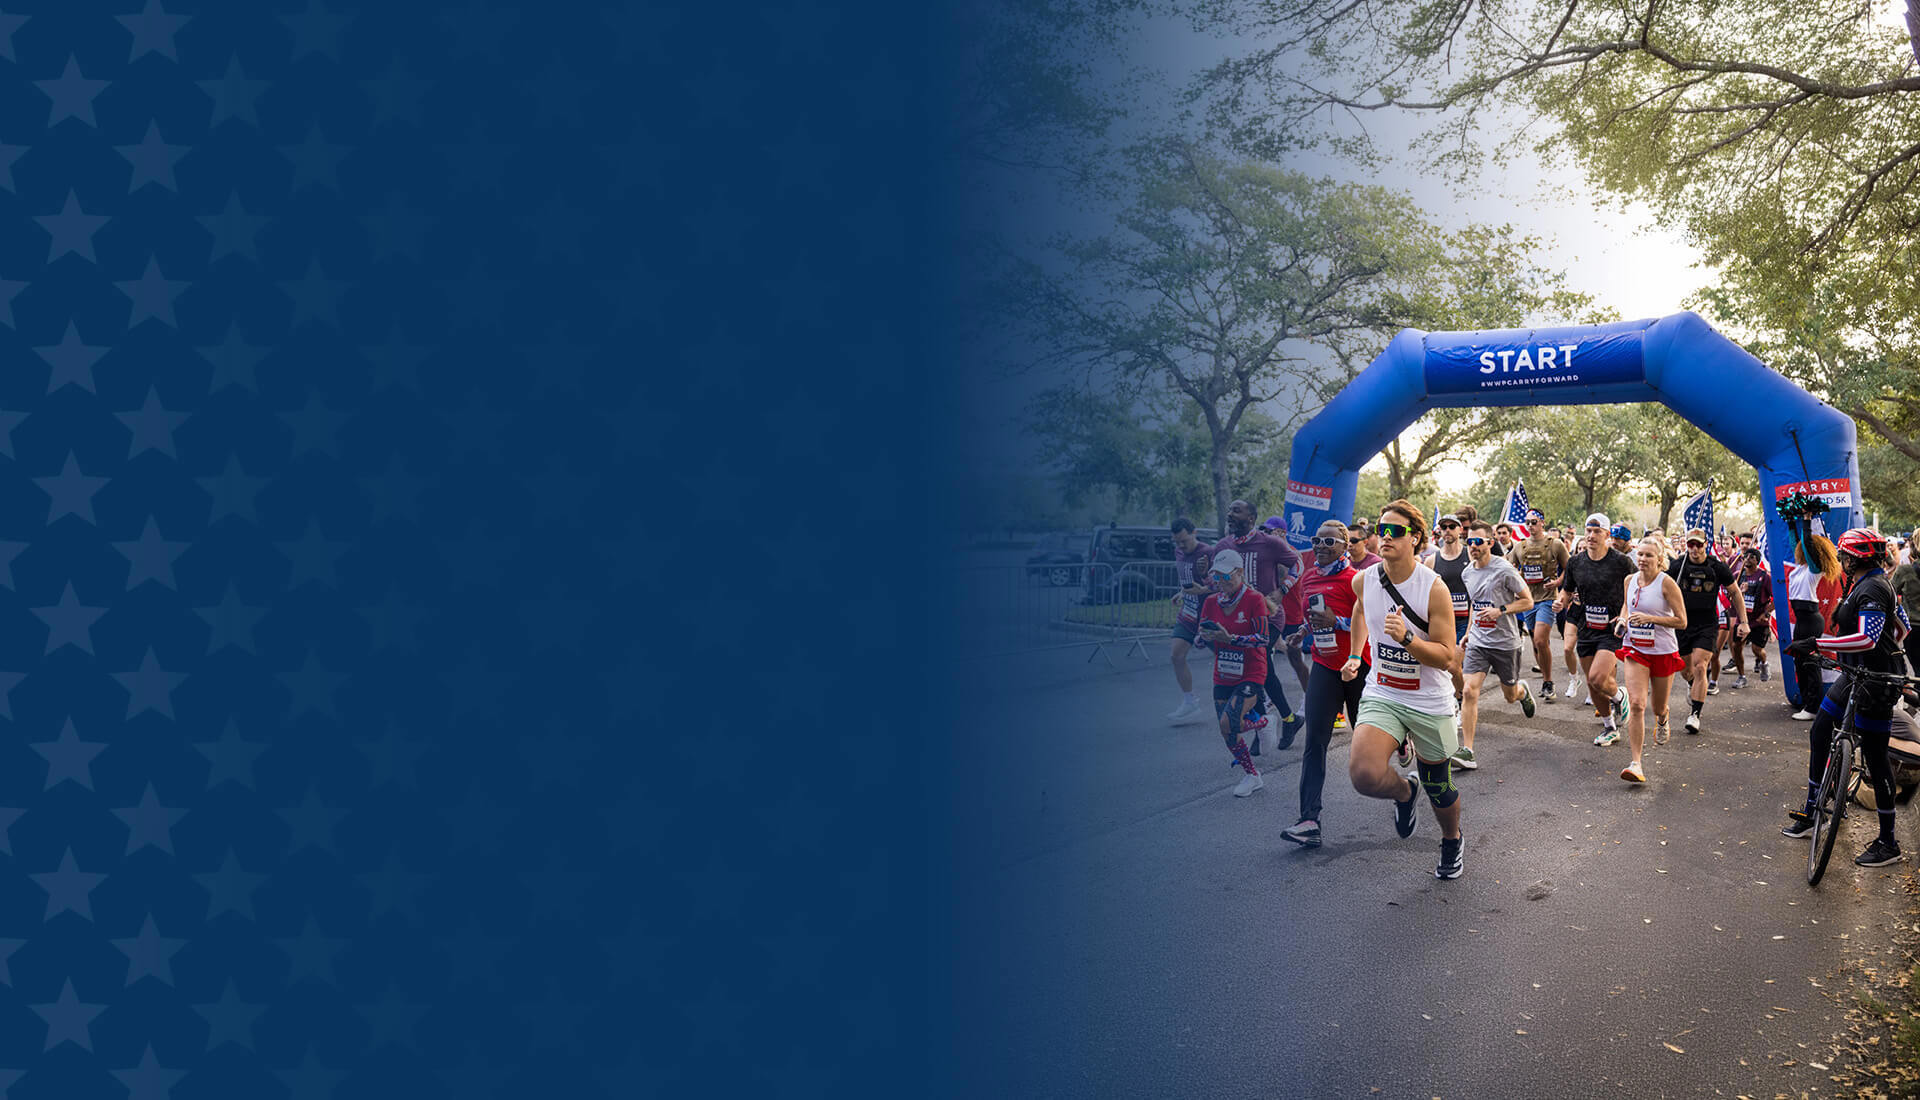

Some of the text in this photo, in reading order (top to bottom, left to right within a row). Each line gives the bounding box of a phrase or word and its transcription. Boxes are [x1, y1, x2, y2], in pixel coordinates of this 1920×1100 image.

[1479, 345, 1578, 374] START
[1481, 375, 1579, 387] #WWPCARRYFORWARD
[1290, 483, 1322, 496] CARRY
[1788, 482, 1838, 495] CARRY
[1835, 496, 1847, 504] 5K
[1219, 651, 1244, 661] 23304
